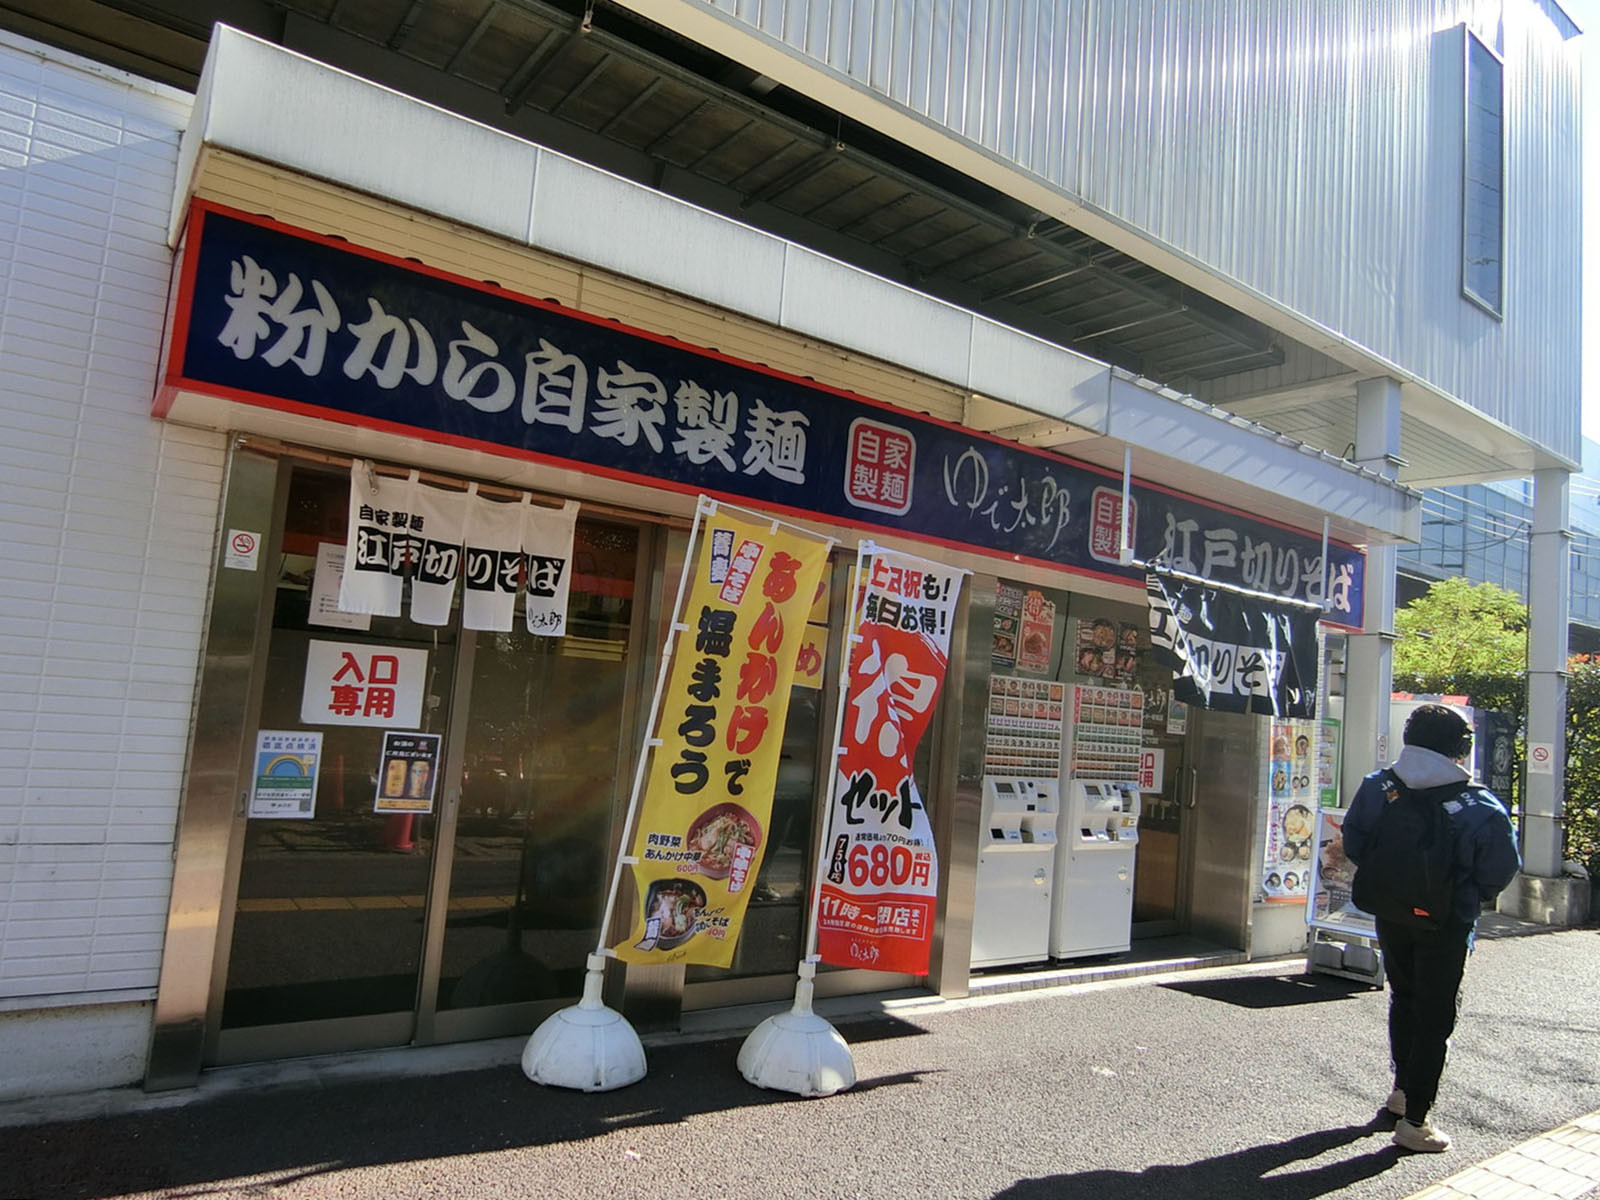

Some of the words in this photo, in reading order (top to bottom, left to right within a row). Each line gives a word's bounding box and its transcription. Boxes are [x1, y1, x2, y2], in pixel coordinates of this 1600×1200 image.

[218, 254, 811, 485] 粉から自家製麺
[855, 428, 910, 470] 自家
[852, 464, 906, 503] 製麺
[943, 446, 1071, 553] ゆで太郎
[359, 504, 425, 532] 自家製麺
[357, 529, 562, 593] 江戸切りそば
[721, 542, 761, 602] 中華そば
[1163, 511, 1354, 613] 江戸切りそば
[865, 592, 946, 636] 毎日お得!
[332, 651, 399, 685] 入口
[724, 550, 802, 796] あんかけで
[328, 685, 395, 719] 専用
[670, 605, 736, 796] 温まろう
[848, 637, 938, 768] 得
[841, 770, 923, 831] セット
[645, 849, 702, 861] あんかけ中華
[647, 834, 682, 847] 肉野菜
[848, 843, 930, 887] 680円
